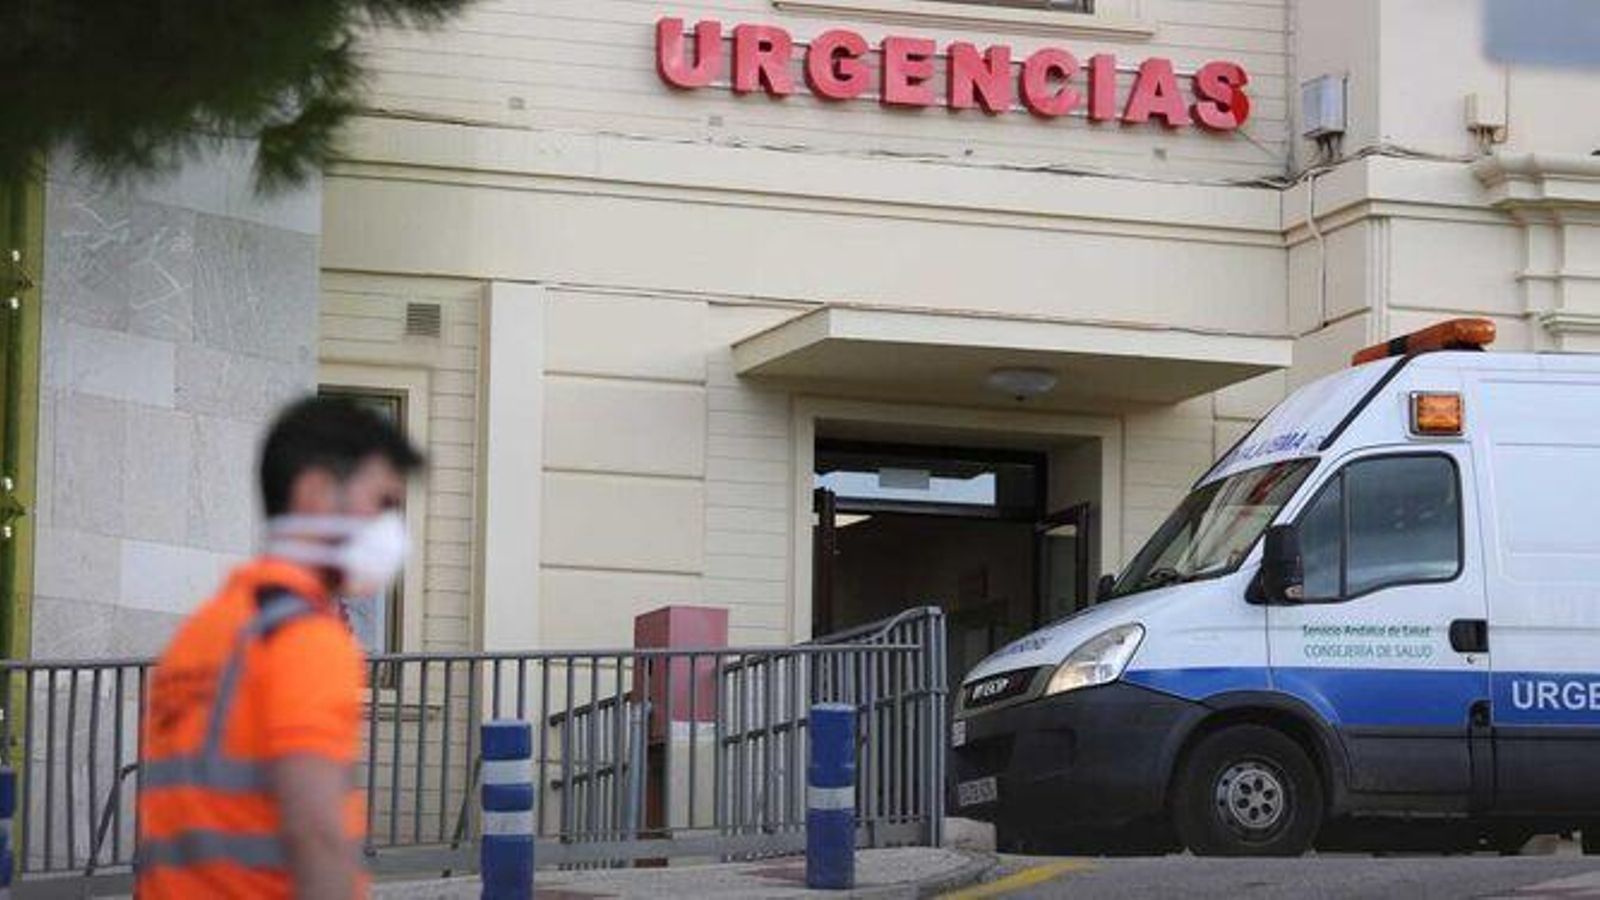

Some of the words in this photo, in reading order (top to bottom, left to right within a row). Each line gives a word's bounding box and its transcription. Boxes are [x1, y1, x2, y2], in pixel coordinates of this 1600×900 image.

[655, 16, 1250, 132] URGENCIAS
[1376, 644, 1392, 657] DE
[1395, 644, 1433, 658] SALUD
